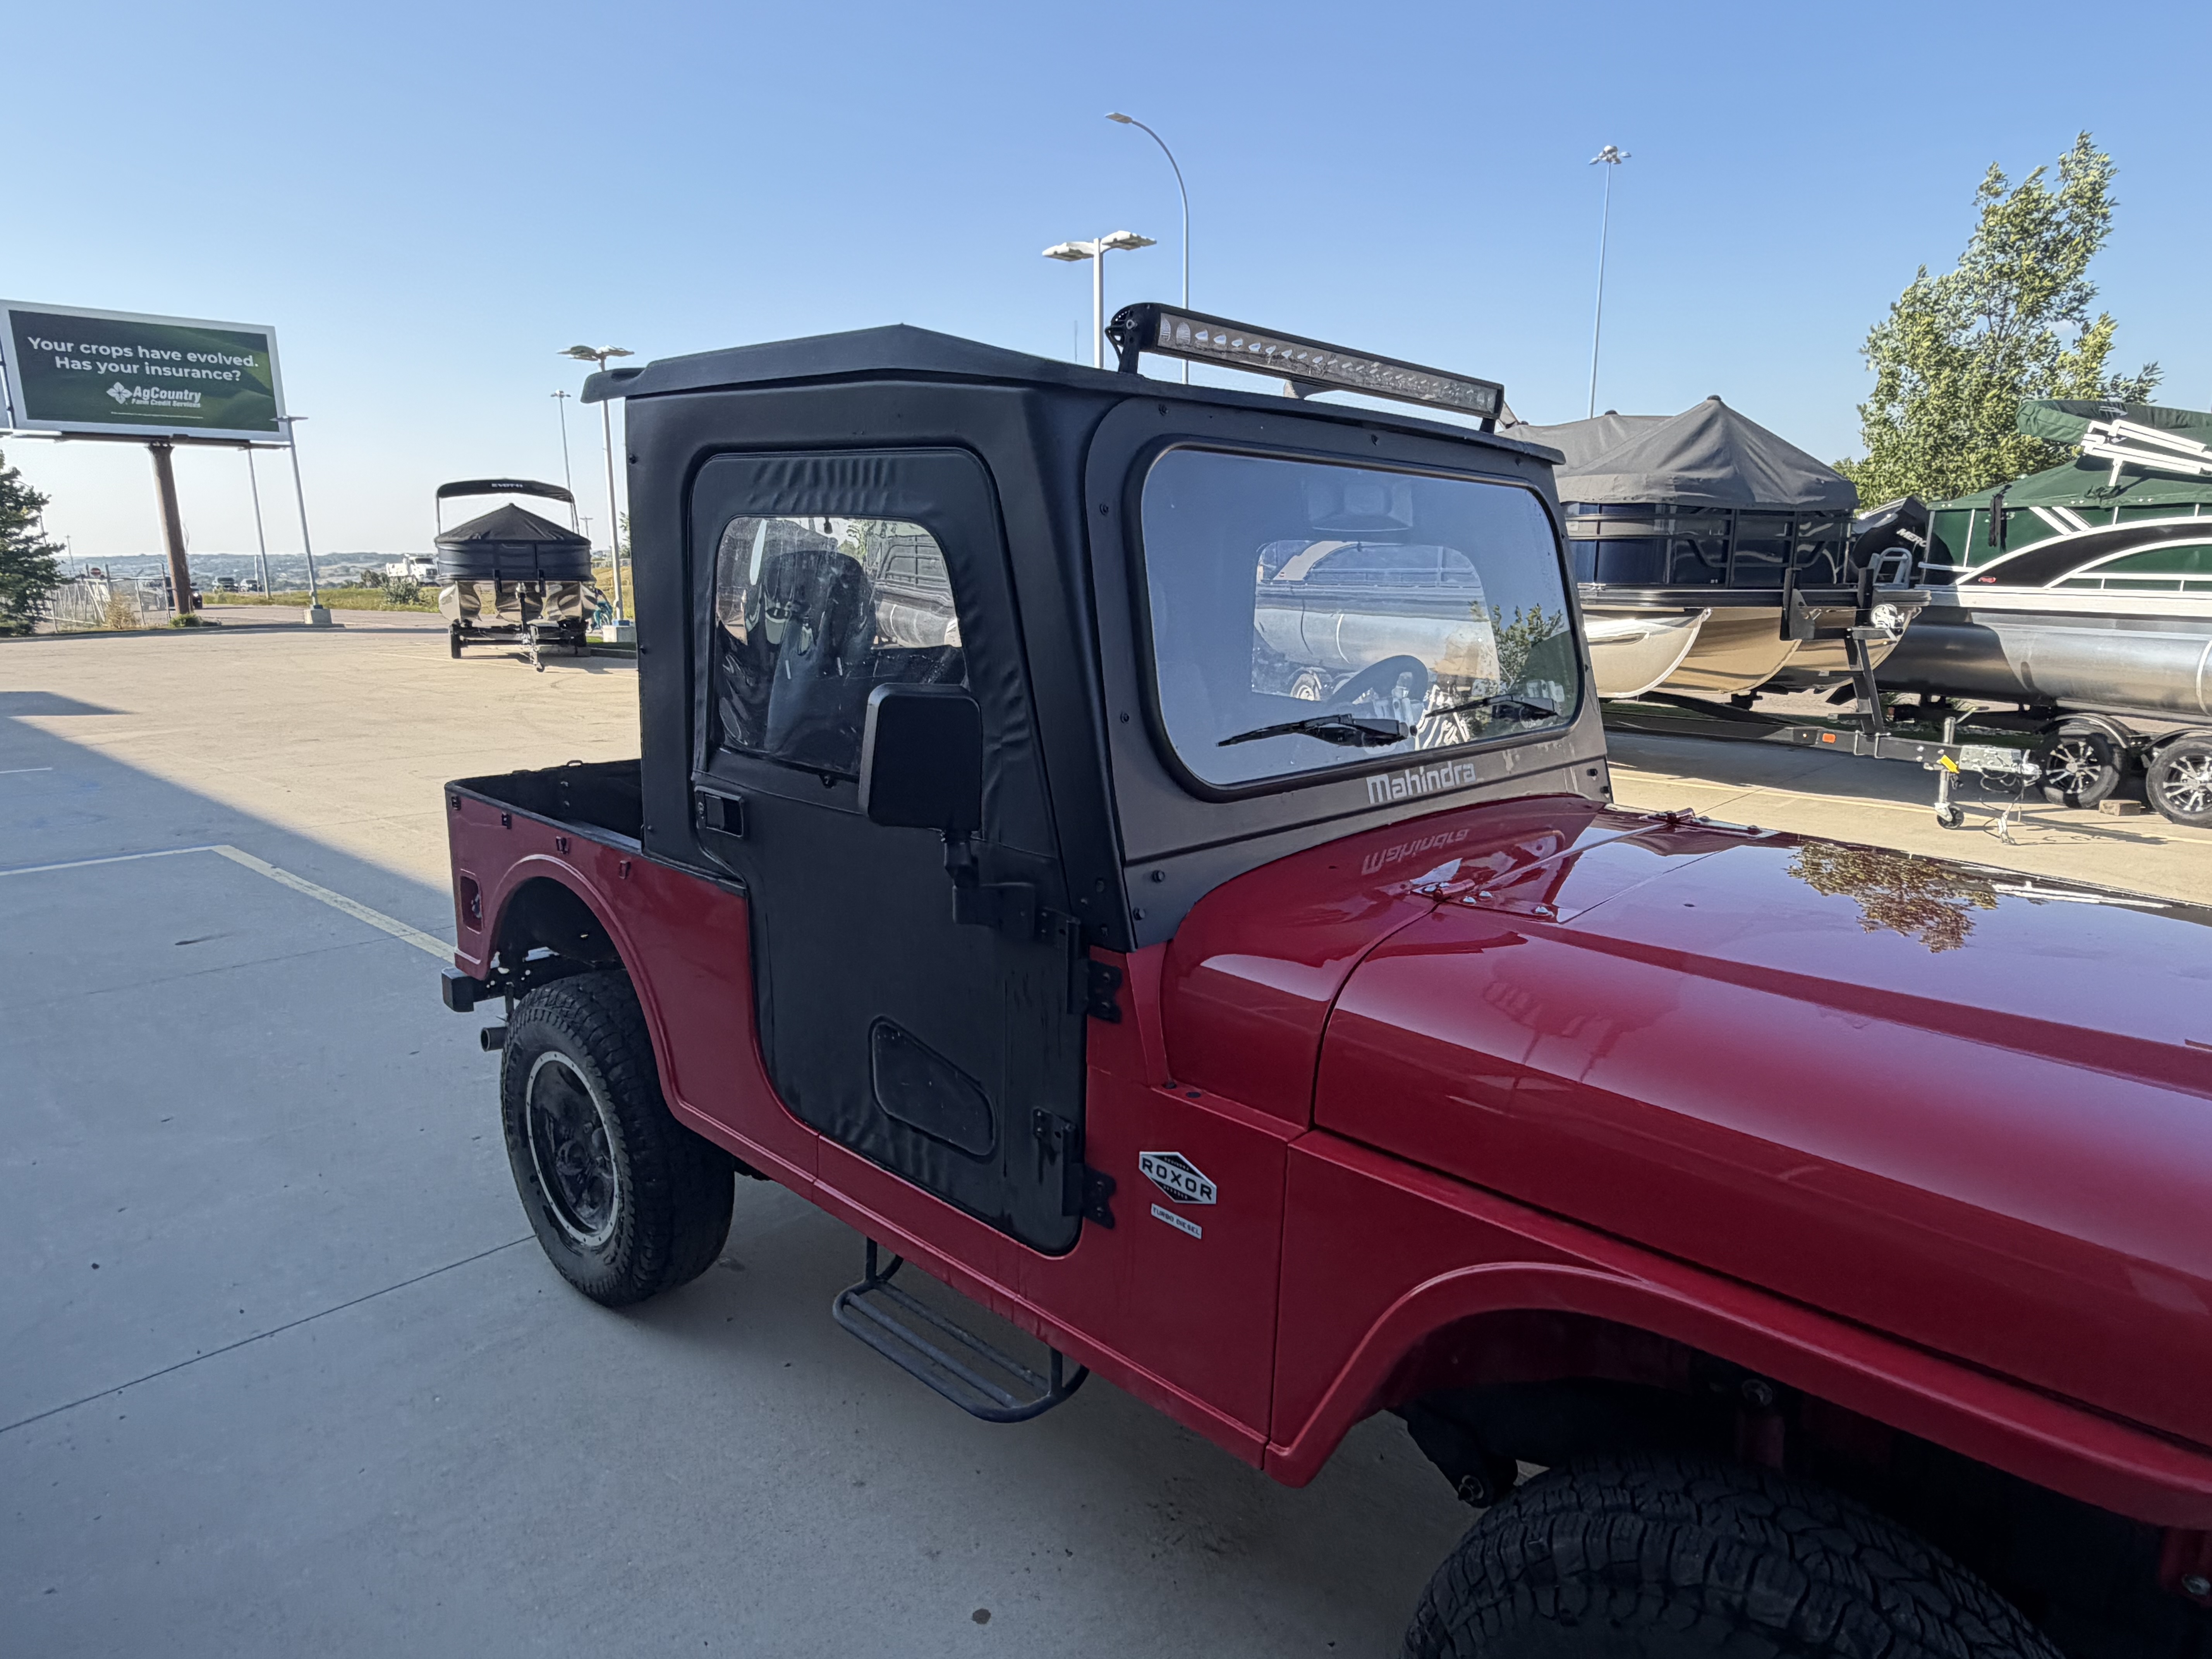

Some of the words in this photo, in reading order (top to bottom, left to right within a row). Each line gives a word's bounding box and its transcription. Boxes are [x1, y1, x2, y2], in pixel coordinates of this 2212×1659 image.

[27, 336, 74, 352] Your
[80, 344, 133, 359] crops
[137, 345, 182, 361] have
[187, 352, 258, 367] evolved.
[55, 356, 92, 370] Has
[96, 361, 139, 374] your
[144, 362, 241, 381] insurance?
[133, 386, 201, 403] AgCountry
[1365, 761, 1477, 804] Mahindra
[1142, 1157, 1212, 1201] ROXOR
[1153, 1206, 1174, 1222] TURBO
[1176, 1218, 1200, 1236] DIESEL
